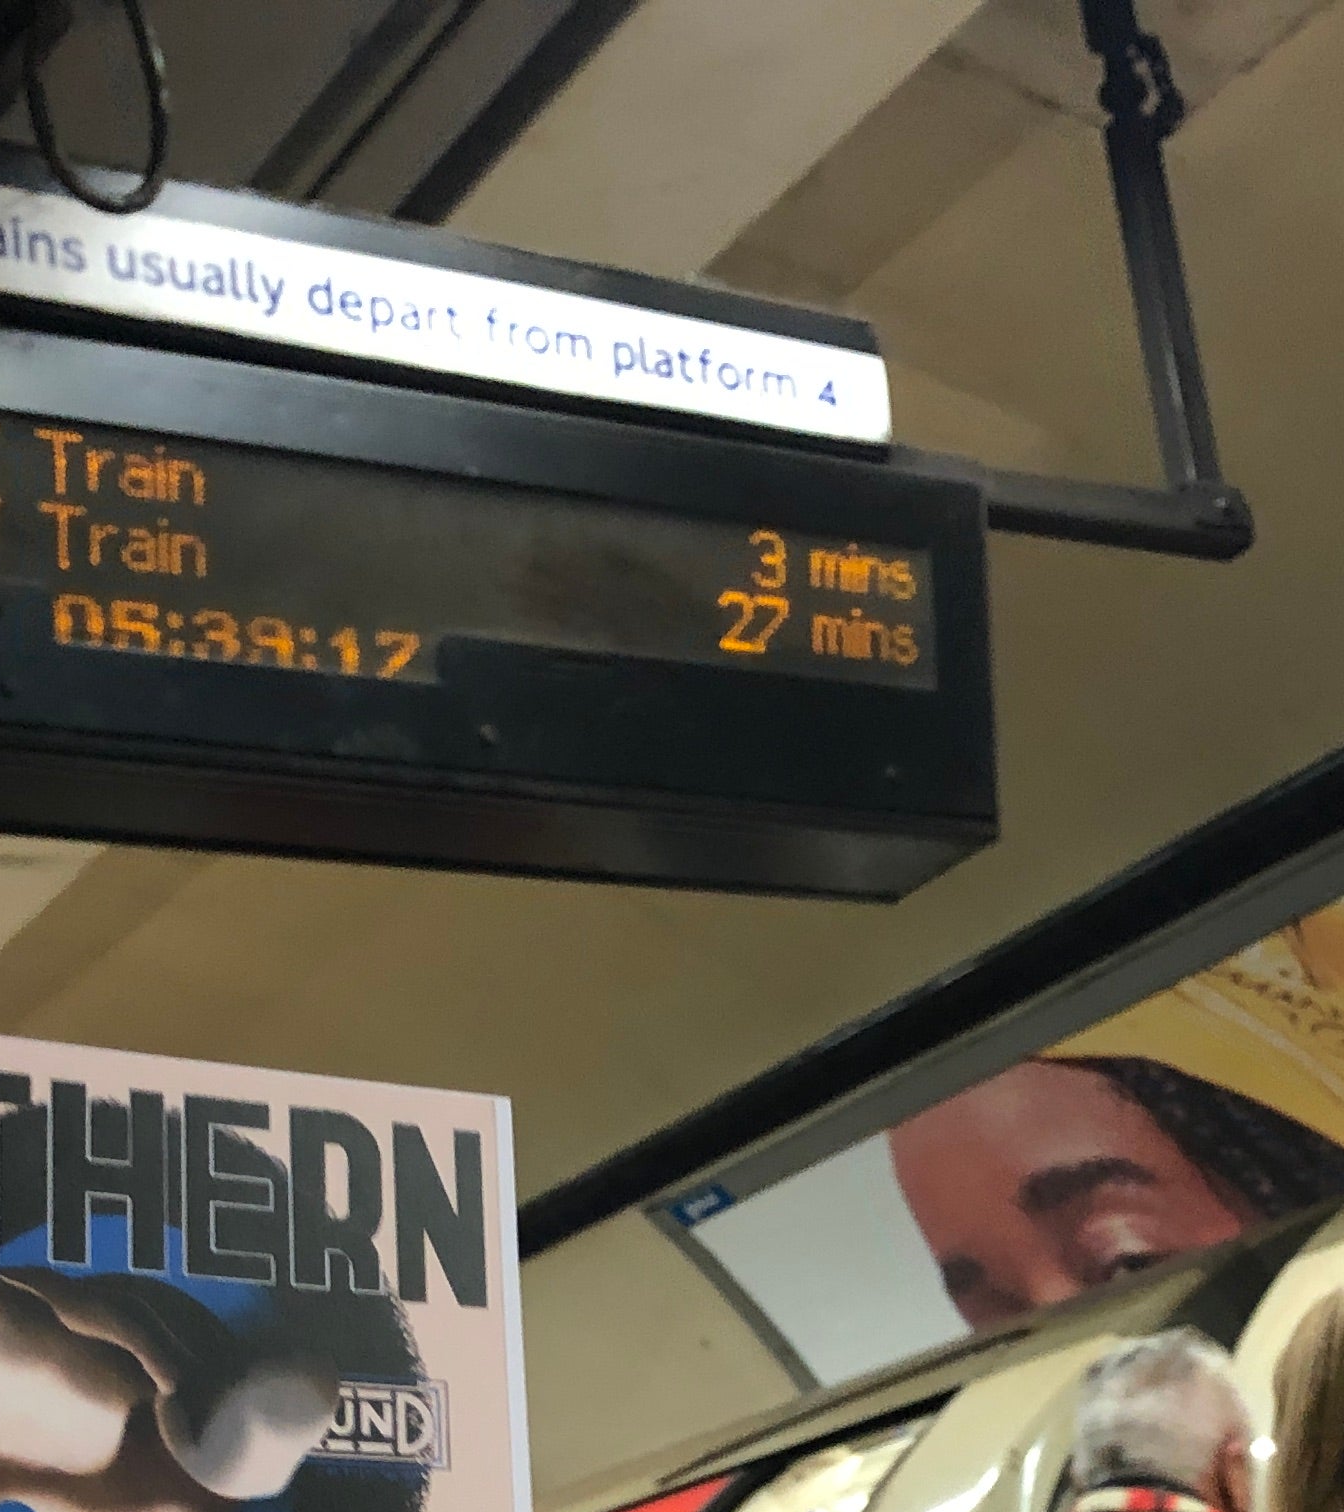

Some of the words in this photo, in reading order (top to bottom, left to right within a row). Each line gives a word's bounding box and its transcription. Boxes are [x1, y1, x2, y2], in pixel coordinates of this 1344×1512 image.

[106, 232, 285, 316] usually
[308, 275, 460, 338] depart
[485, 307, 592, 361] from
[612, 338, 798, 400] platform
[817, 379, 837, 407] 4
[33, 426, 207, 506] Train
[748, 528, 787, 589] 3
[809, 542, 918, 601] mins
[36, 500, 209, 578] Train
[716, 589, 792, 655] 27
[811, 607, 920, 667] mins
